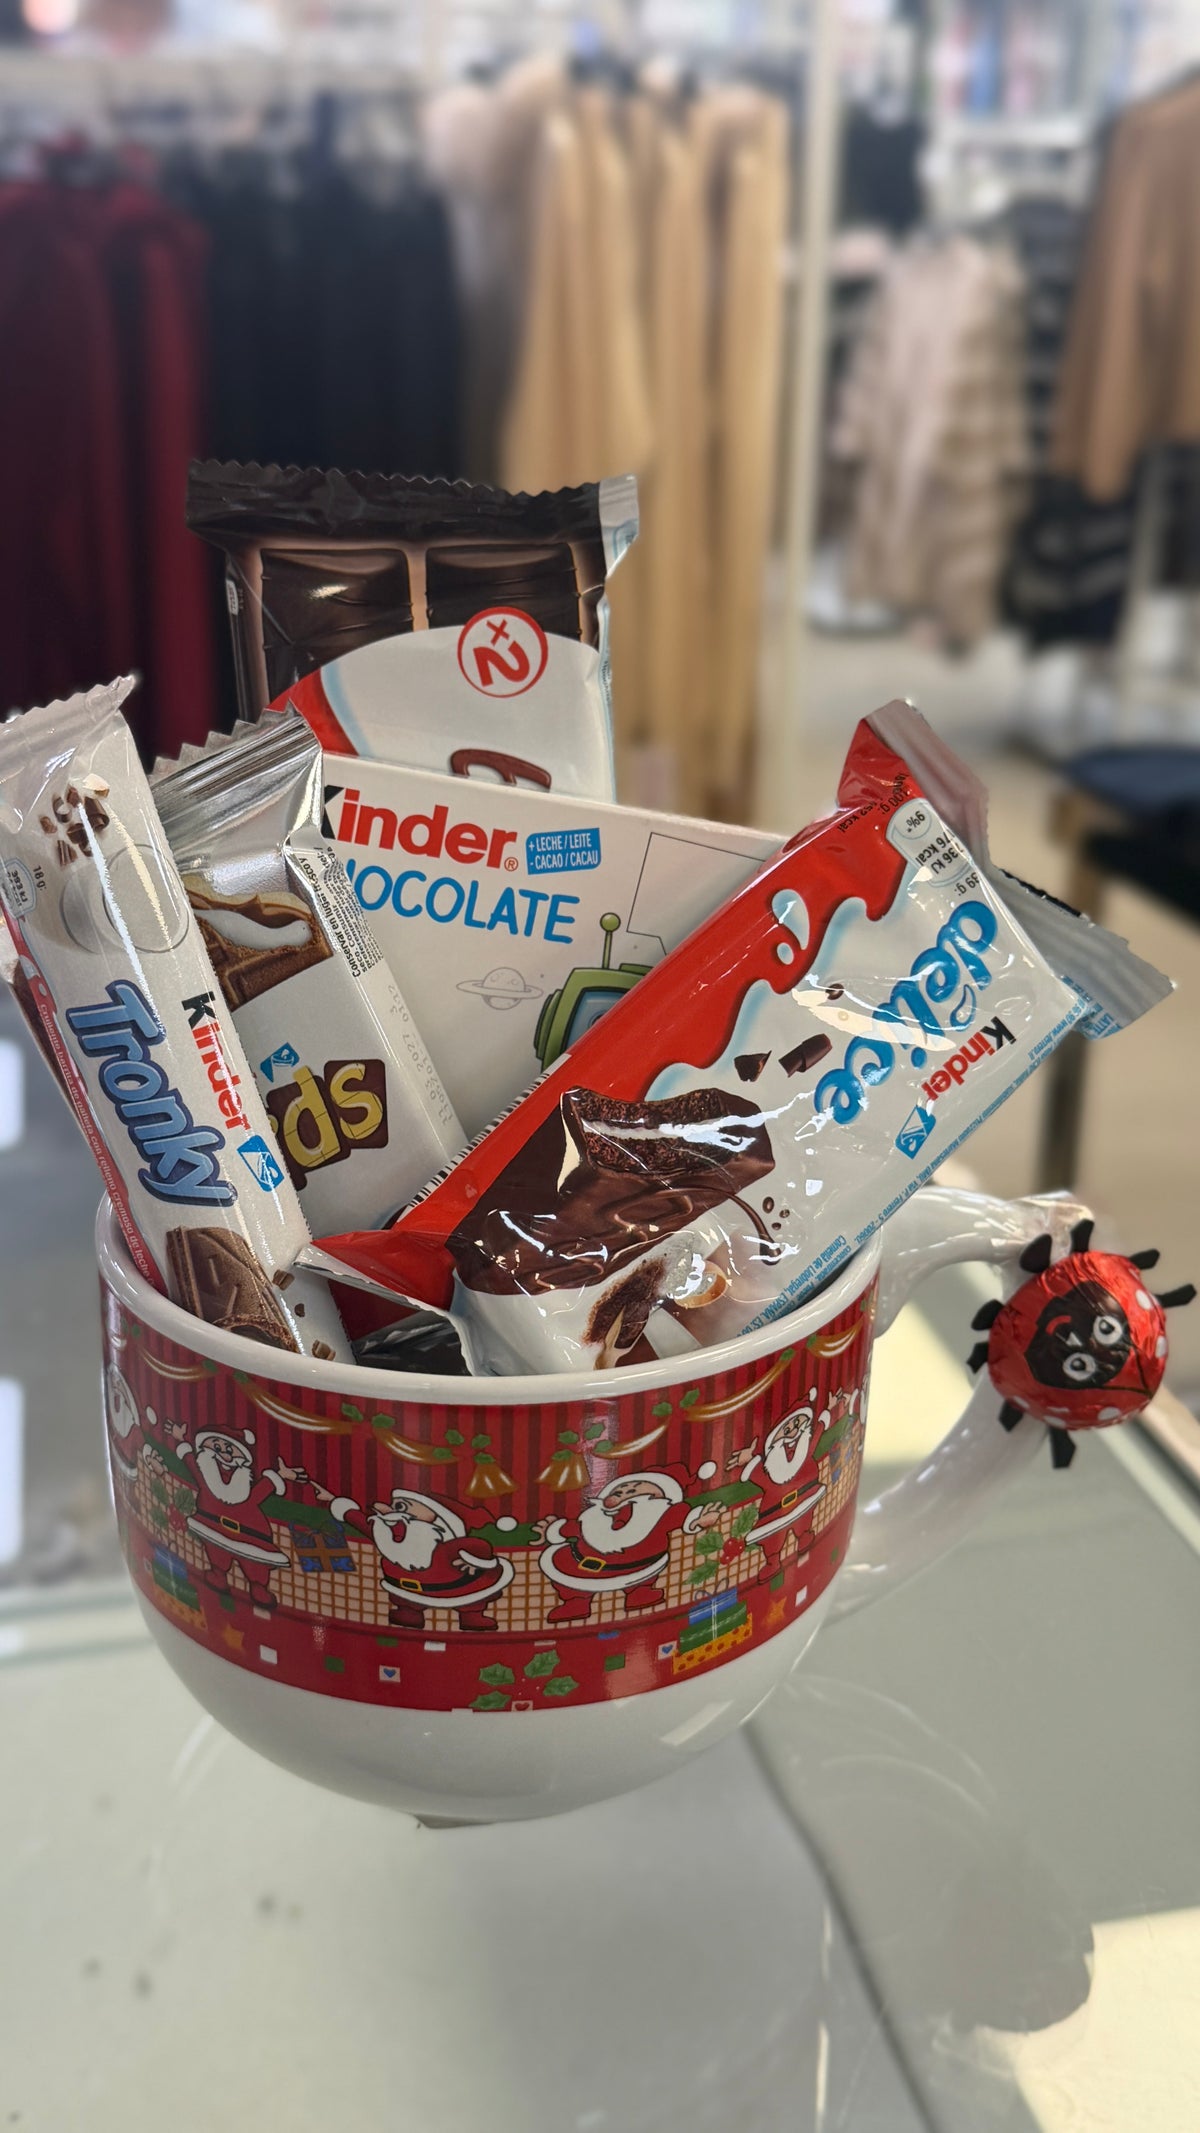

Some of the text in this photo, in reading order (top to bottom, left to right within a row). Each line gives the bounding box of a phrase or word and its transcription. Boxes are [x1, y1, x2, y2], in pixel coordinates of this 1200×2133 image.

[536, 836, 563, 850] LECHE
[570, 833, 592, 848] LEITE
[914, 843, 938, 866] kcal
[298, 855, 307, 863] y
[535, 854, 563, 870] CACAO
[570, 850, 598, 867] CACAU
[929, 858, 945, 874] kJ
[32, 865, 47, 891] 18 g:
[951, 881, 967, 897] g:
[315, 891, 334, 917] lugar
[347, 858, 580, 944] OCOLATE
[328, 916, 339, 930] en
[330, 903, 356, 948] Consumir
[333, 929, 361, 977] Conservar
[351, 947, 367, 973] seco.
[65, 979, 238, 1207] Tronky
[128, 1234, 140, 1248] de
[134, 1248, 151, 1277] leche
[819, 1234, 848, 1263] Cornellà
[811, 1256, 825, 1270] de
[760, 1292, 790, 1321] ESPAÑA.
